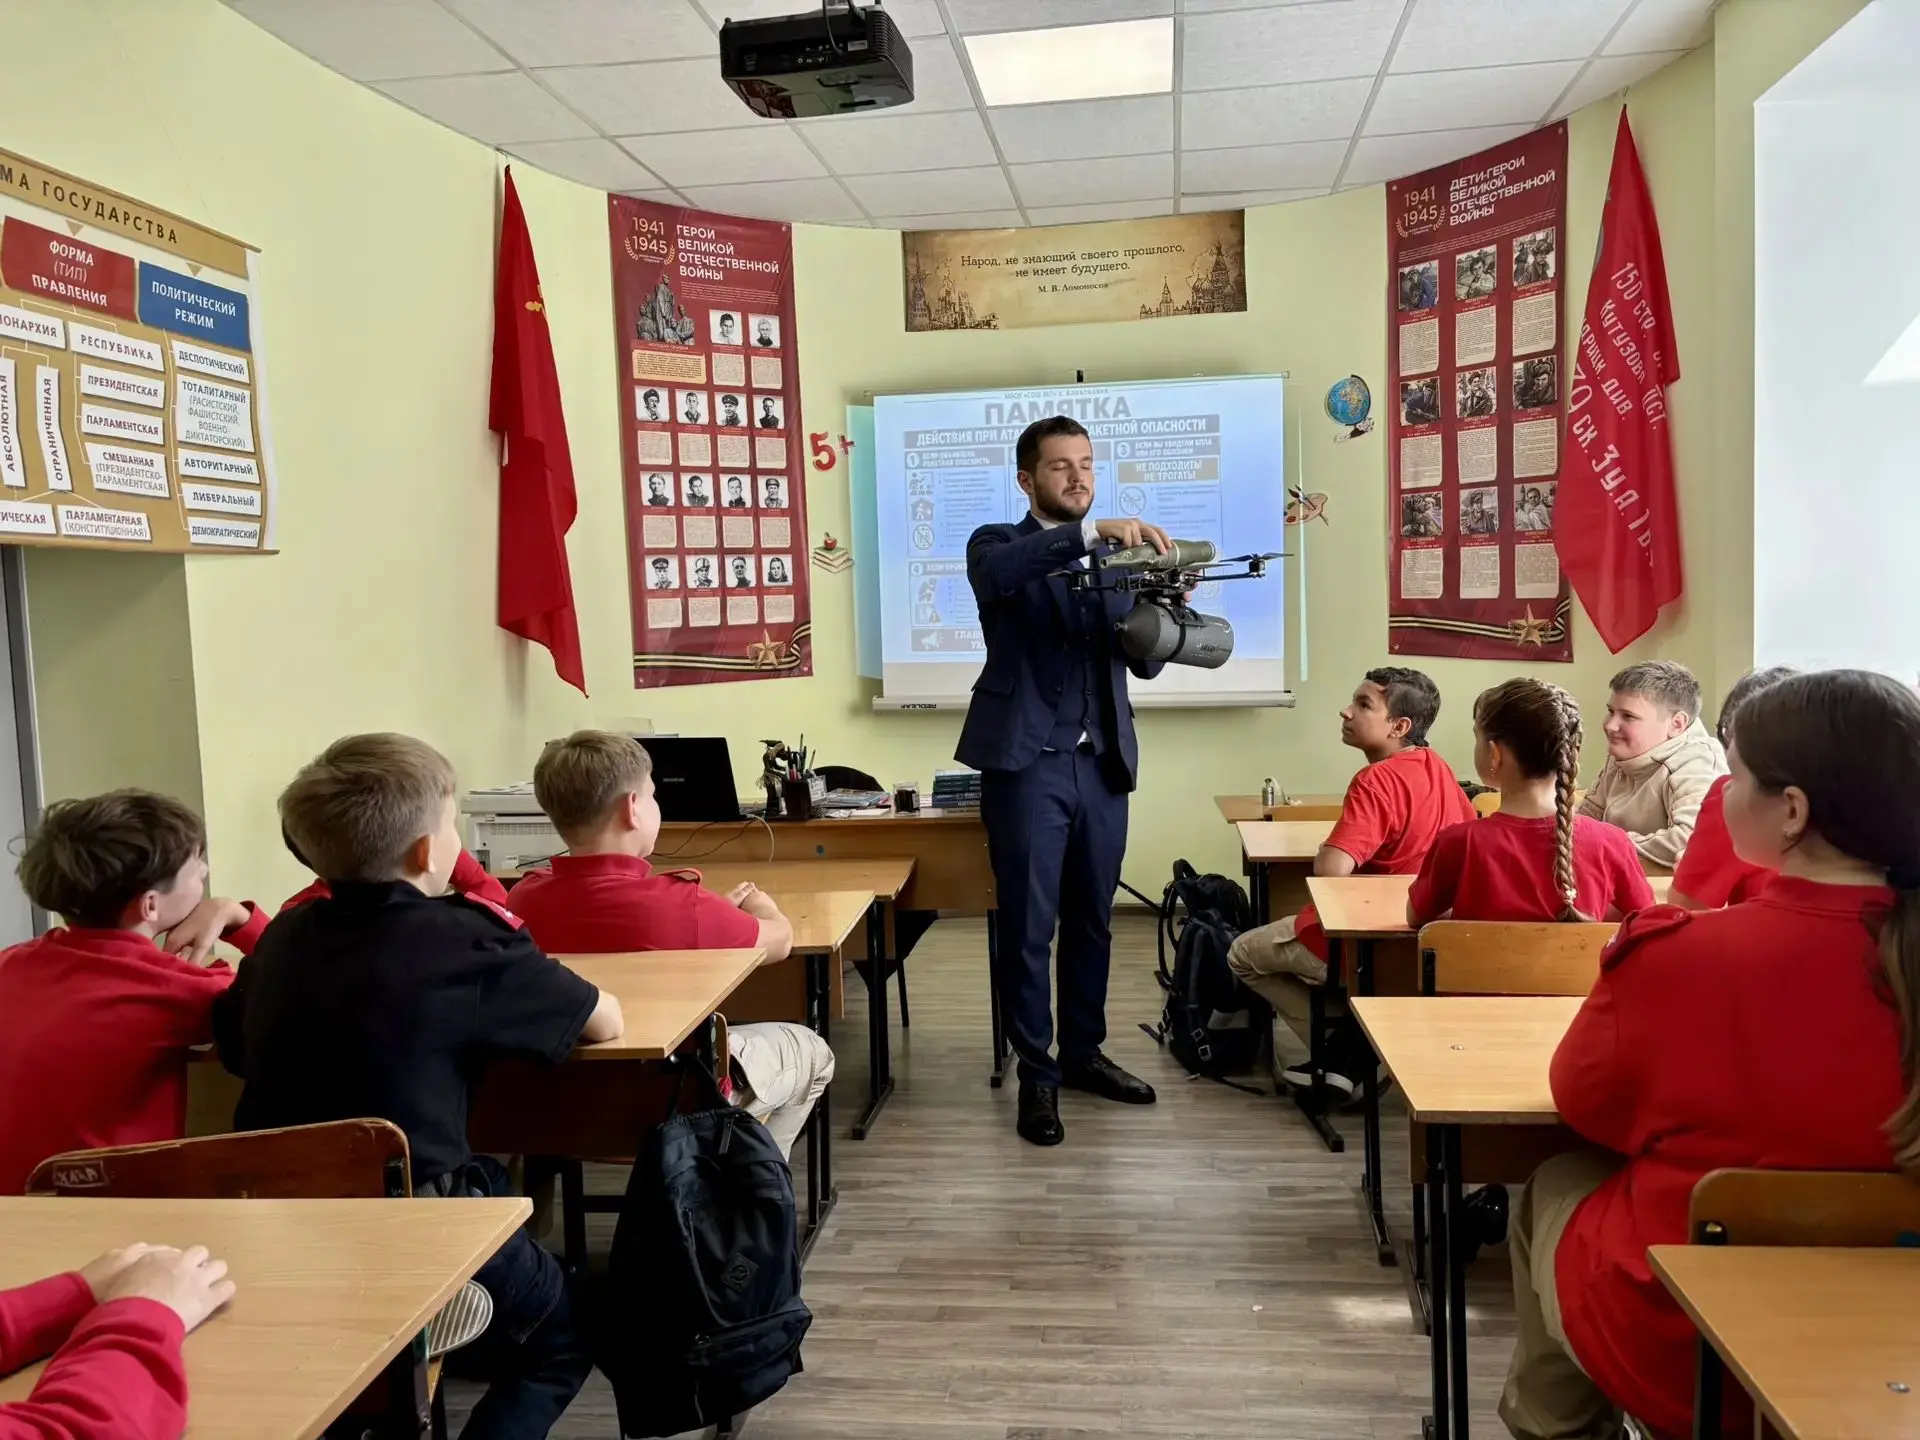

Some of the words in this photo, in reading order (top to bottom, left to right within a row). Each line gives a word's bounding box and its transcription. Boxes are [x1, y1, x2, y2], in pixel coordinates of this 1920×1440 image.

[1450, 156, 1526, 191] ДЕТИ-ГЕРОИ
[1404, 185, 1436, 207] 1941
[1450, 173, 1506, 202] ВЕЛИКОЙ
[1450, 169, 1556, 214] ОТЕЧЕСТВЕННОЙ
[43, 180, 177, 244] ГОСУДАРСТВА
[1403, 205, 1438, 227] 1945
[1450, 204, 1494, 227] ВОЙНЫ
[632, 217, 664, 235] 1941
[676, 225, 715, 240] ГЕРОИ
[49, 240, 94, 266] ФОРМА
[632, 236, 668, 254] 1945
[677, 239, 734, 255] ВЕЛИКОЙ
[961, 255, 1001, 268] Народ,
[1005, 257, 1019, 266] не
[1022, 251, 1076, 266] знающий
[1080, 249, 1119, 261] своего
[1123, 243, 1186, 259] прошлого,
[53, 259, 88, 284] (ТИП)
[678, 252, 780, 273] ОТЕЧЕСТВЕННОЙ
[679, 264, 723, 281] ВОЙНЫ
[1015, 269, 1029, 278] не
[1032, 266, 1067, 276] имеет
[1071, 261, 1131, 276] будущего.
[32, 274, 108, 307] ПРАВЛЕНИЯ
[1611, 262, 1643, 300] 150
[152, 280, 236, 317] ПОЛИТИЧЕСКИЙ
[0, 314, 57, 337] ОНАРХИЯ
[175, 308, 215, 329] РЕЖИМ
[80, 334, 154, 361] РЕСПУБЛИКА
[178, 349, 245, 376] ДЕСПОТИЧЕСКИЙ
[87, 374, 158, 398] ПРЕЗИДЕНТСКАЯ
[182, 380, 246, 404] ТОТАЛИТАРНЫЙ
[984, 396, 1131, 425] ПАМЯТКА
[1601, 378, 1633, 421] ДИВ.
[0, 375, 15, 472] АБСОЛЮТНАЯ
[43, 378, 64, 481] ОГРАНИЧЕННАЯ
[86, 414, 159, 436] ПАРЛАМЕНТСКАЯ
[917, 430, 972, 447] ДЕЙСТВИЯ
[976, 429, 998, 443] ПРИ
[1085, 419, 1138, 438] АКЕТНОЙ
[1140, 418, 1206, 434] ОПАСНОСТИ
[185, 430, 246, 449] ДИКТАТОРСКИЙ)
[102, 451, 155, 468] СМЕШАННАЯ
[810, 432, 856, 472] 5+
[96, 462, 163, 481] (ПРЕЗИДЕНТСКО-
[184, 457, 253, 476] АВТОРИТАРНЫЙ
[1136, 462, 1147, 472] НЕ
[1144, 472, 1156, 481] НЕ
[95, 473, 167, 494] ПАРЛАМЕНТСКАЯ)
[192, 491, 255, 508] ЛИБЕРАЛЬНЫЙ
[65, 510, 143, 526] ПАРЛАМЕНТАРНАЯ
[65, 522, 147, 538] (КОНСТИТУЦИОННАЯ)
[191, 525, 258, 541] ДЕМОКРАТИЧЕСКИЙ
